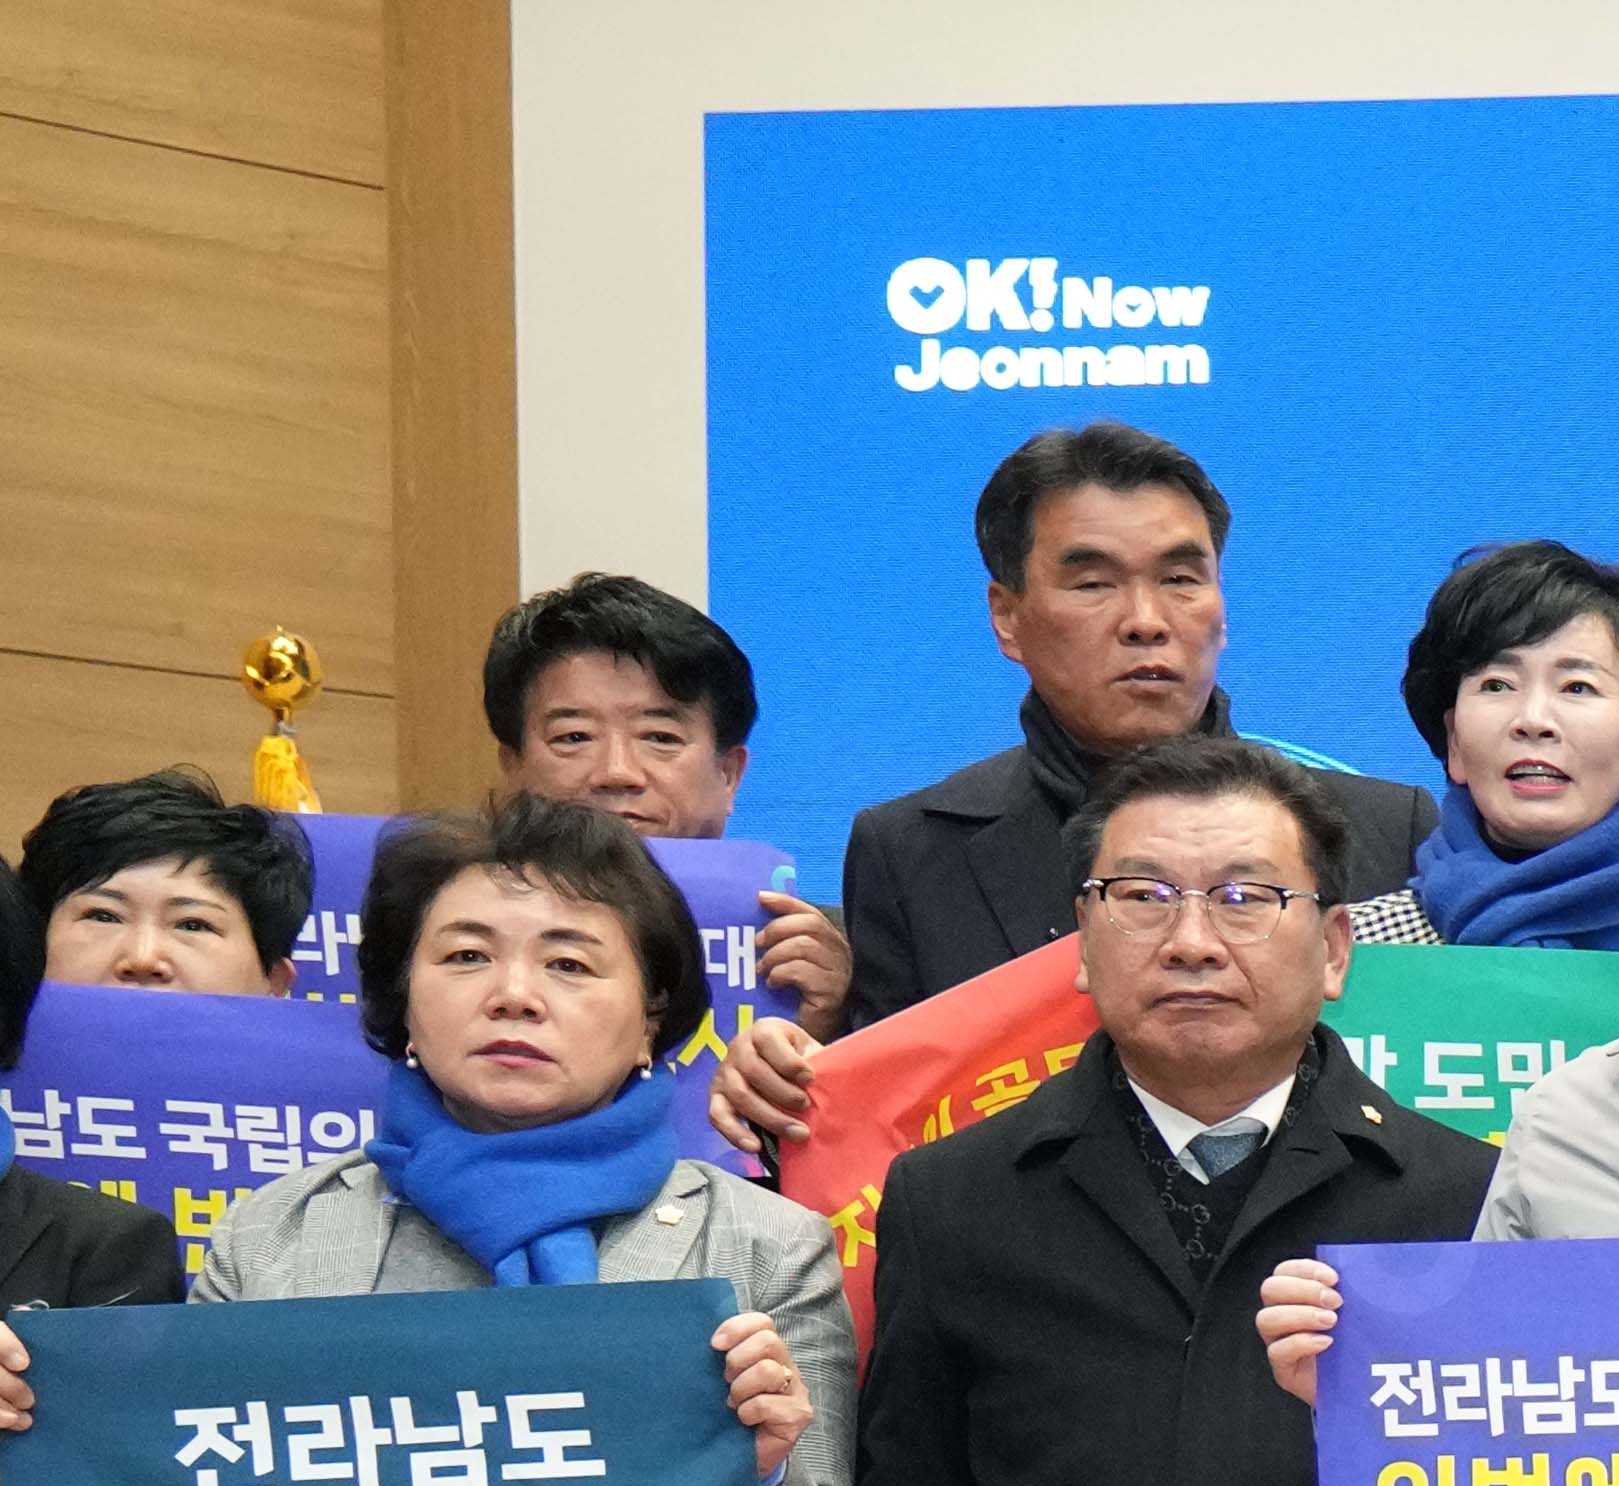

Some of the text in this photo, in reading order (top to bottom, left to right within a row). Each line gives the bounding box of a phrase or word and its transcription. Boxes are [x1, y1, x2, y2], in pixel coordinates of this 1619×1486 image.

[1061, 275, 1211, 329] Now
[894, 338, 1210, 392] Jeonnam
[158, 1097, 377, 1175] 국립의
